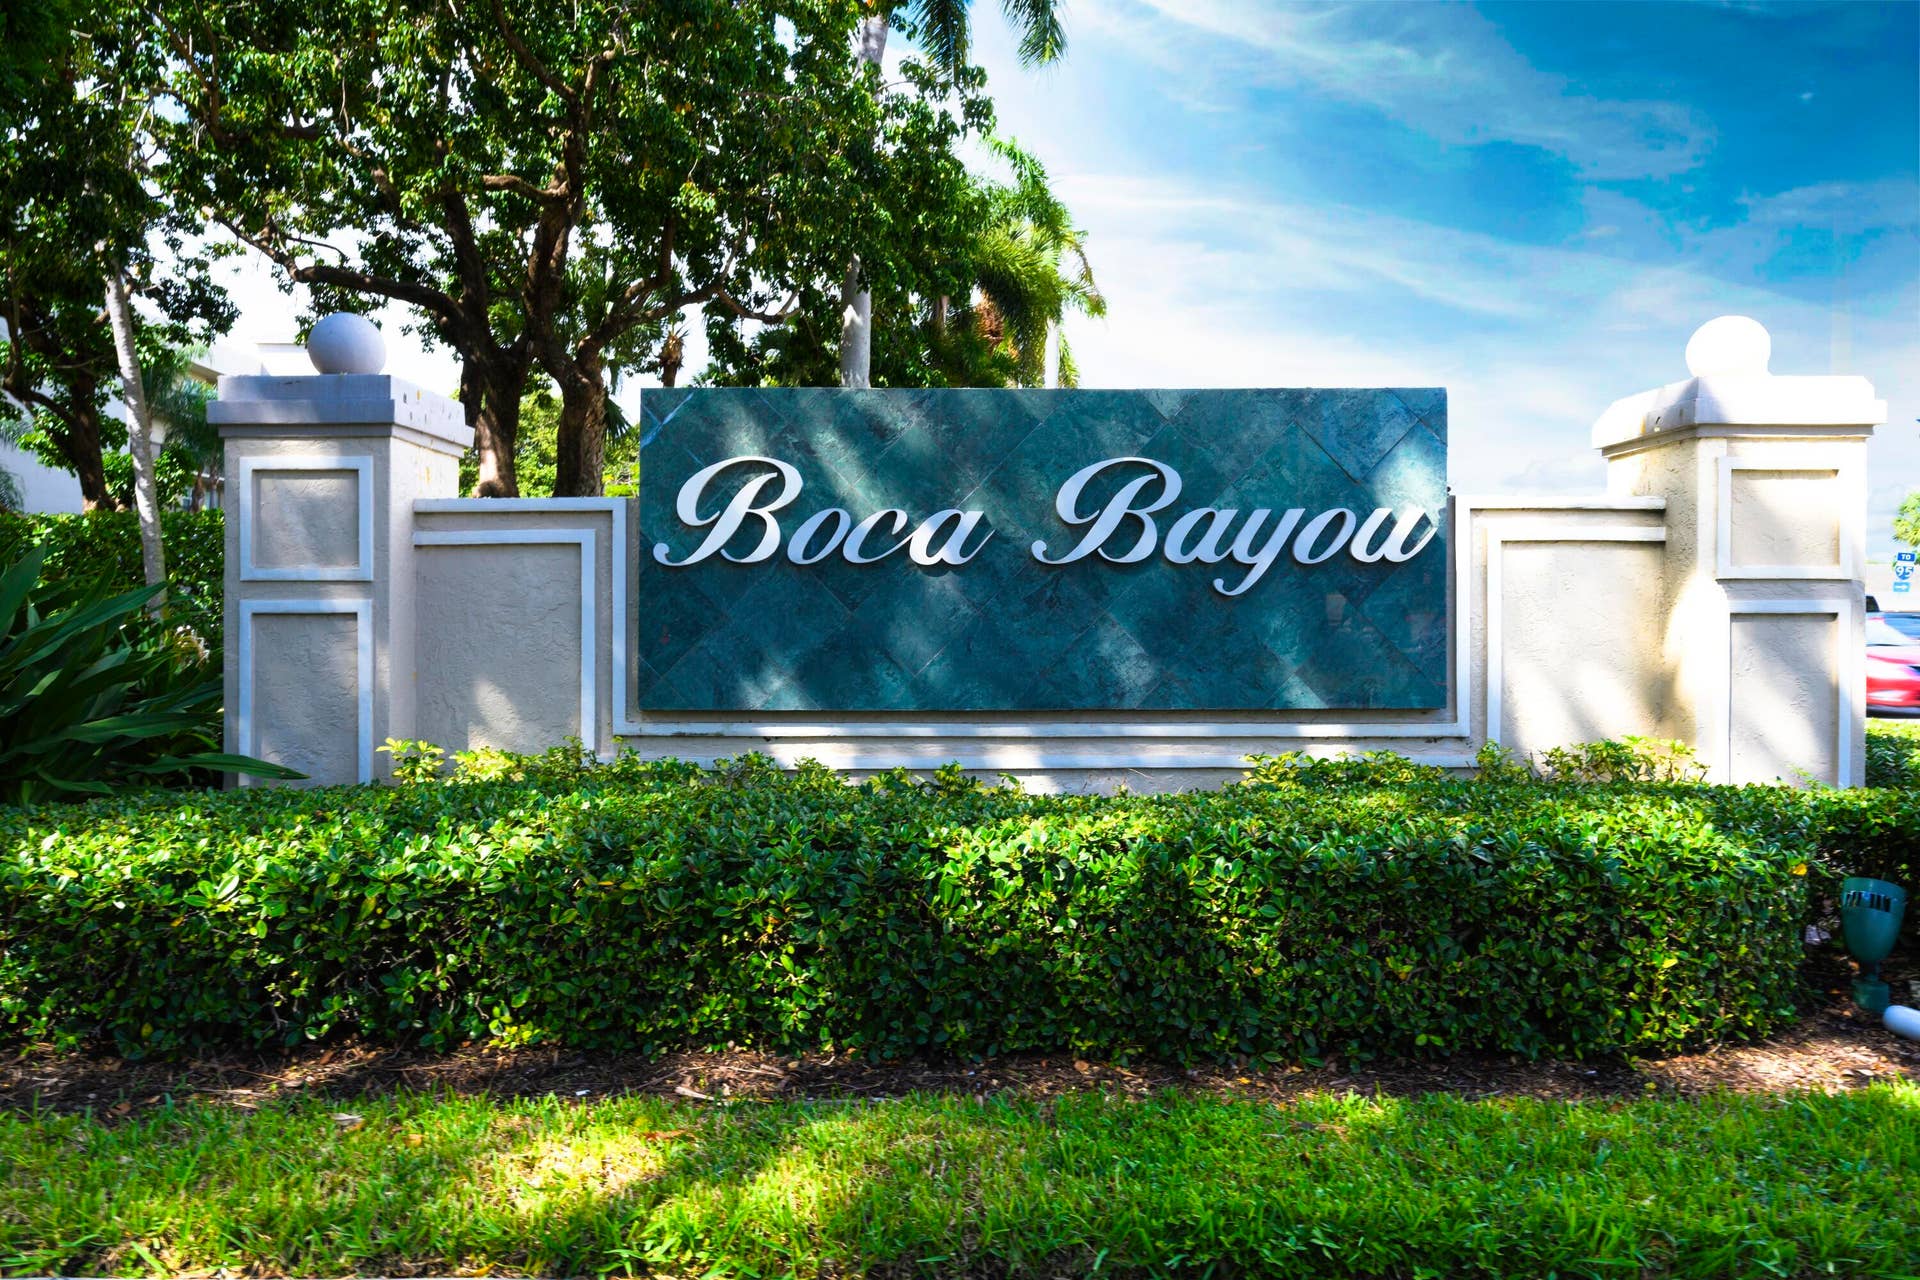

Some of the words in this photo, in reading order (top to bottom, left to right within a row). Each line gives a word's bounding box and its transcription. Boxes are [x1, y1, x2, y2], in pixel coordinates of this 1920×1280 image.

[653, 456, 996, 567] Boca
[1031, 456, 1438, 596] Bayou
[1901, 553, 1911, 561] TO
[1896, 565, 1914, 578] 95
